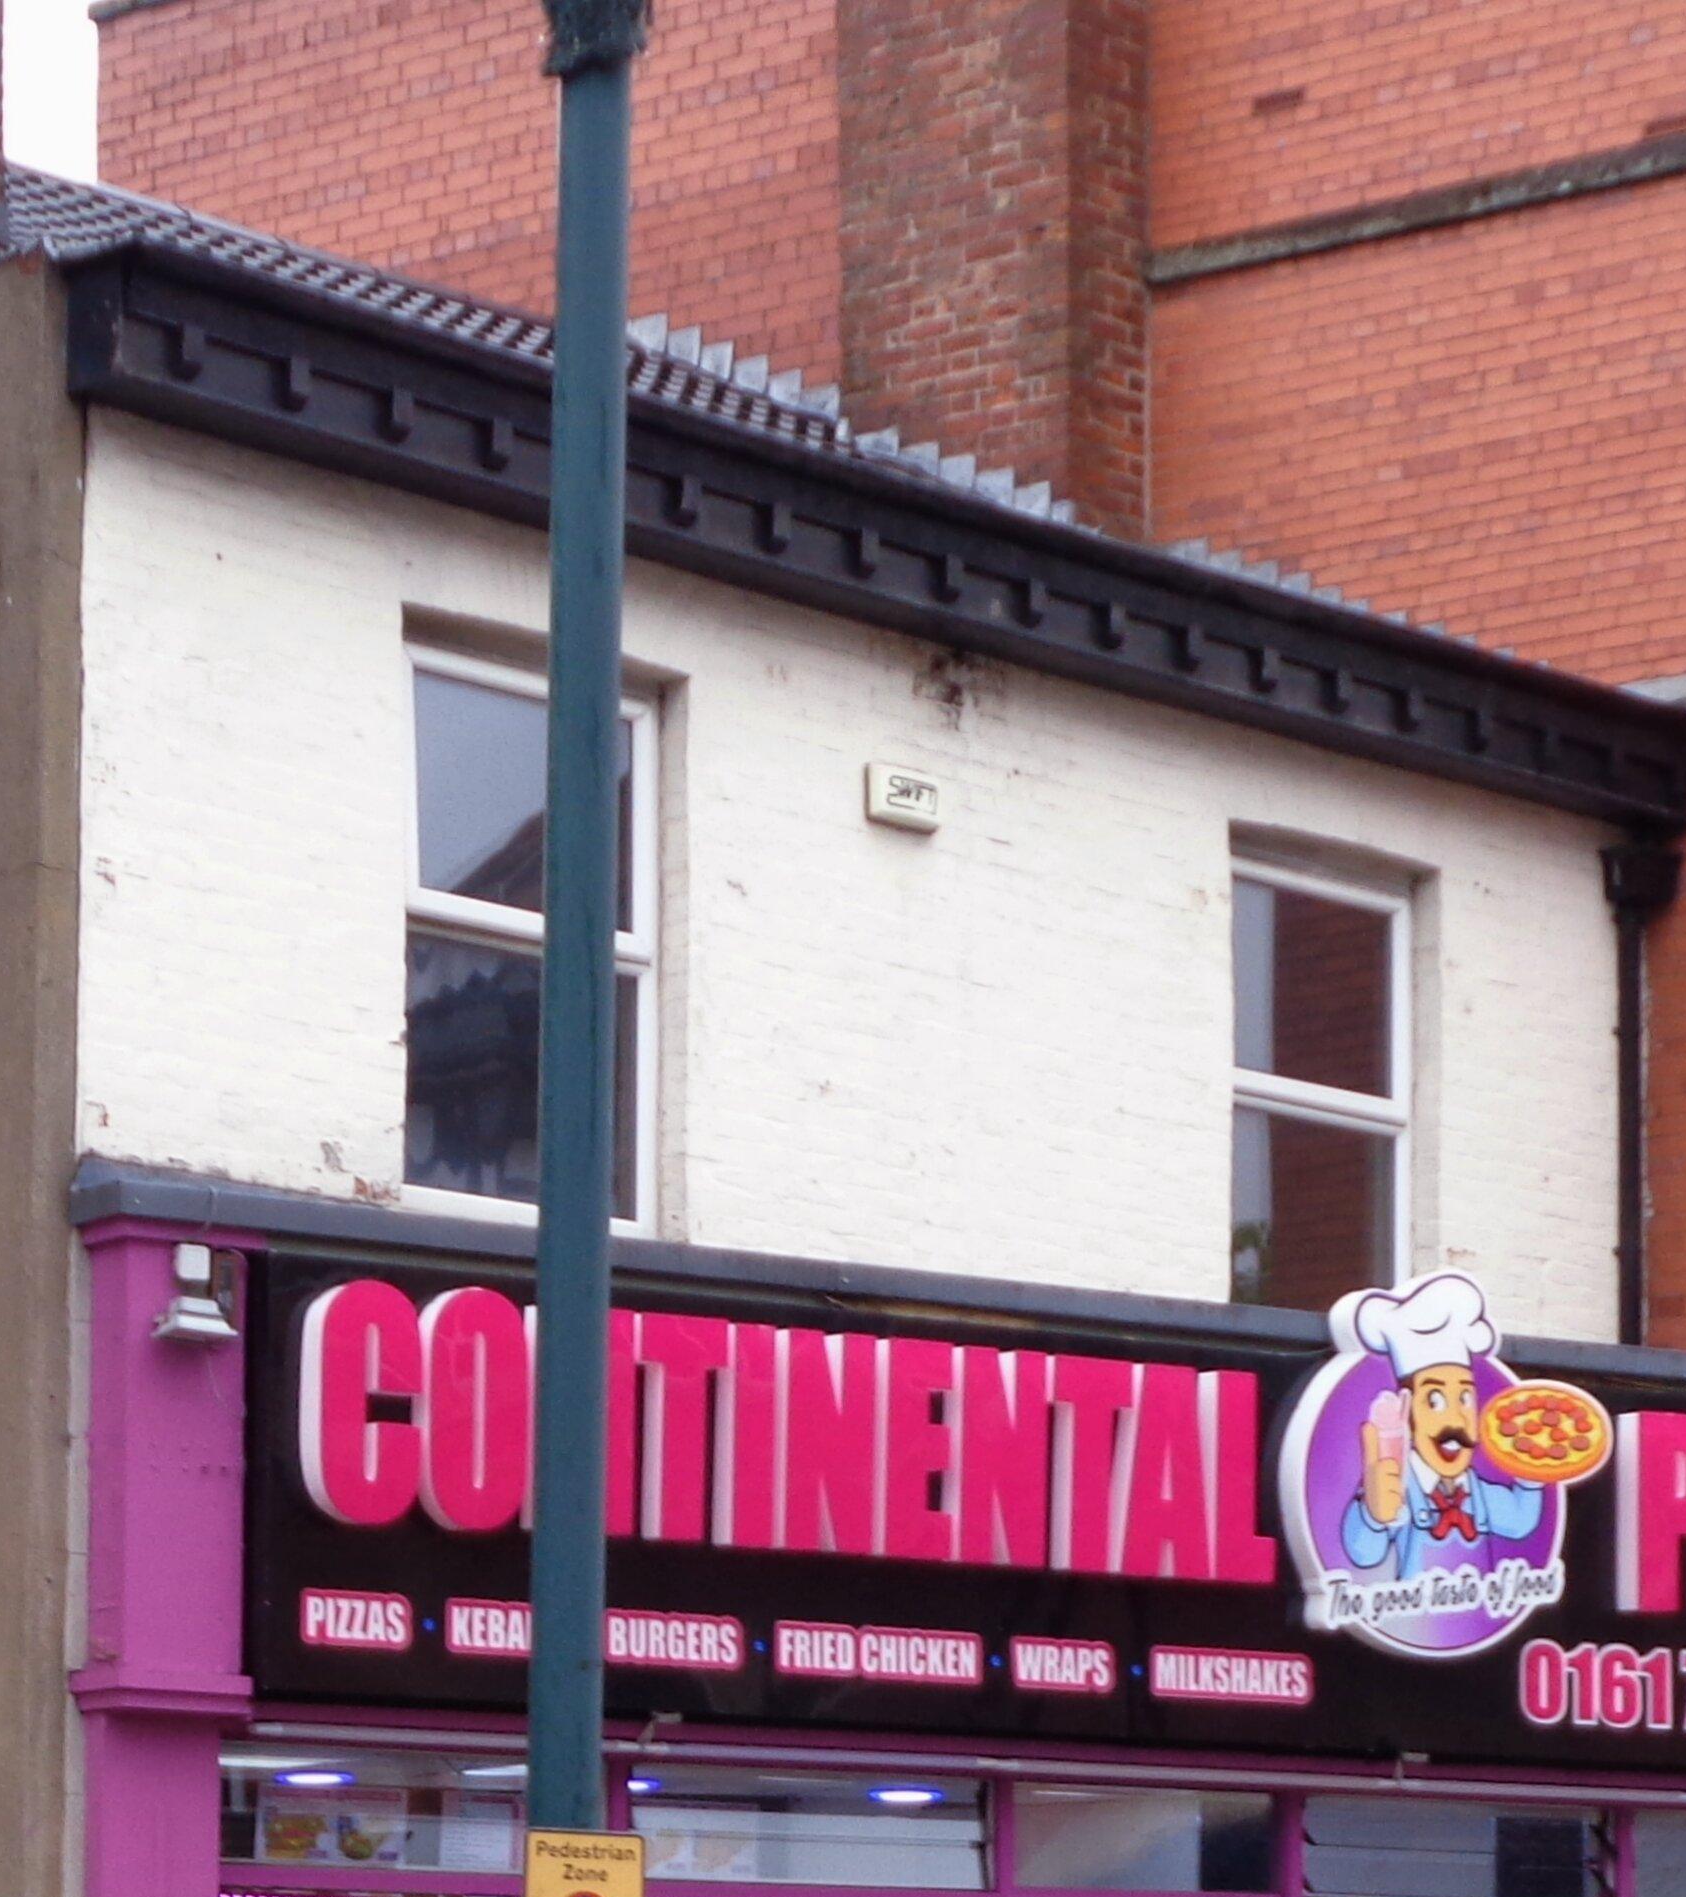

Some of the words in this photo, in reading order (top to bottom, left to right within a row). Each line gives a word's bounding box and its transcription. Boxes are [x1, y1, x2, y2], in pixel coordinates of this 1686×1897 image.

[1370, 1580, 1425, 1622] good
[1430, 1573, 1478, 1607] taste
[305, 1594, 409, 1645] PIZZAS
[451, 1604, 532, 1653] KEBA
[608, 1617, 739, 1665] BURGERS
[779, 1628, 856, 1673] FRIED
[861, 1632, 978, 1680] CHICKEN
[1016, 1644, 1111, 1688] WRAPS
[1155, 1653, 1309, 1699] MILKSHAKES
[1520, 1638, 1673, 1729] 0161
[534, 1839, 637, 1862] Pedestrian
[562, 1863, 609, 1883] Zone
